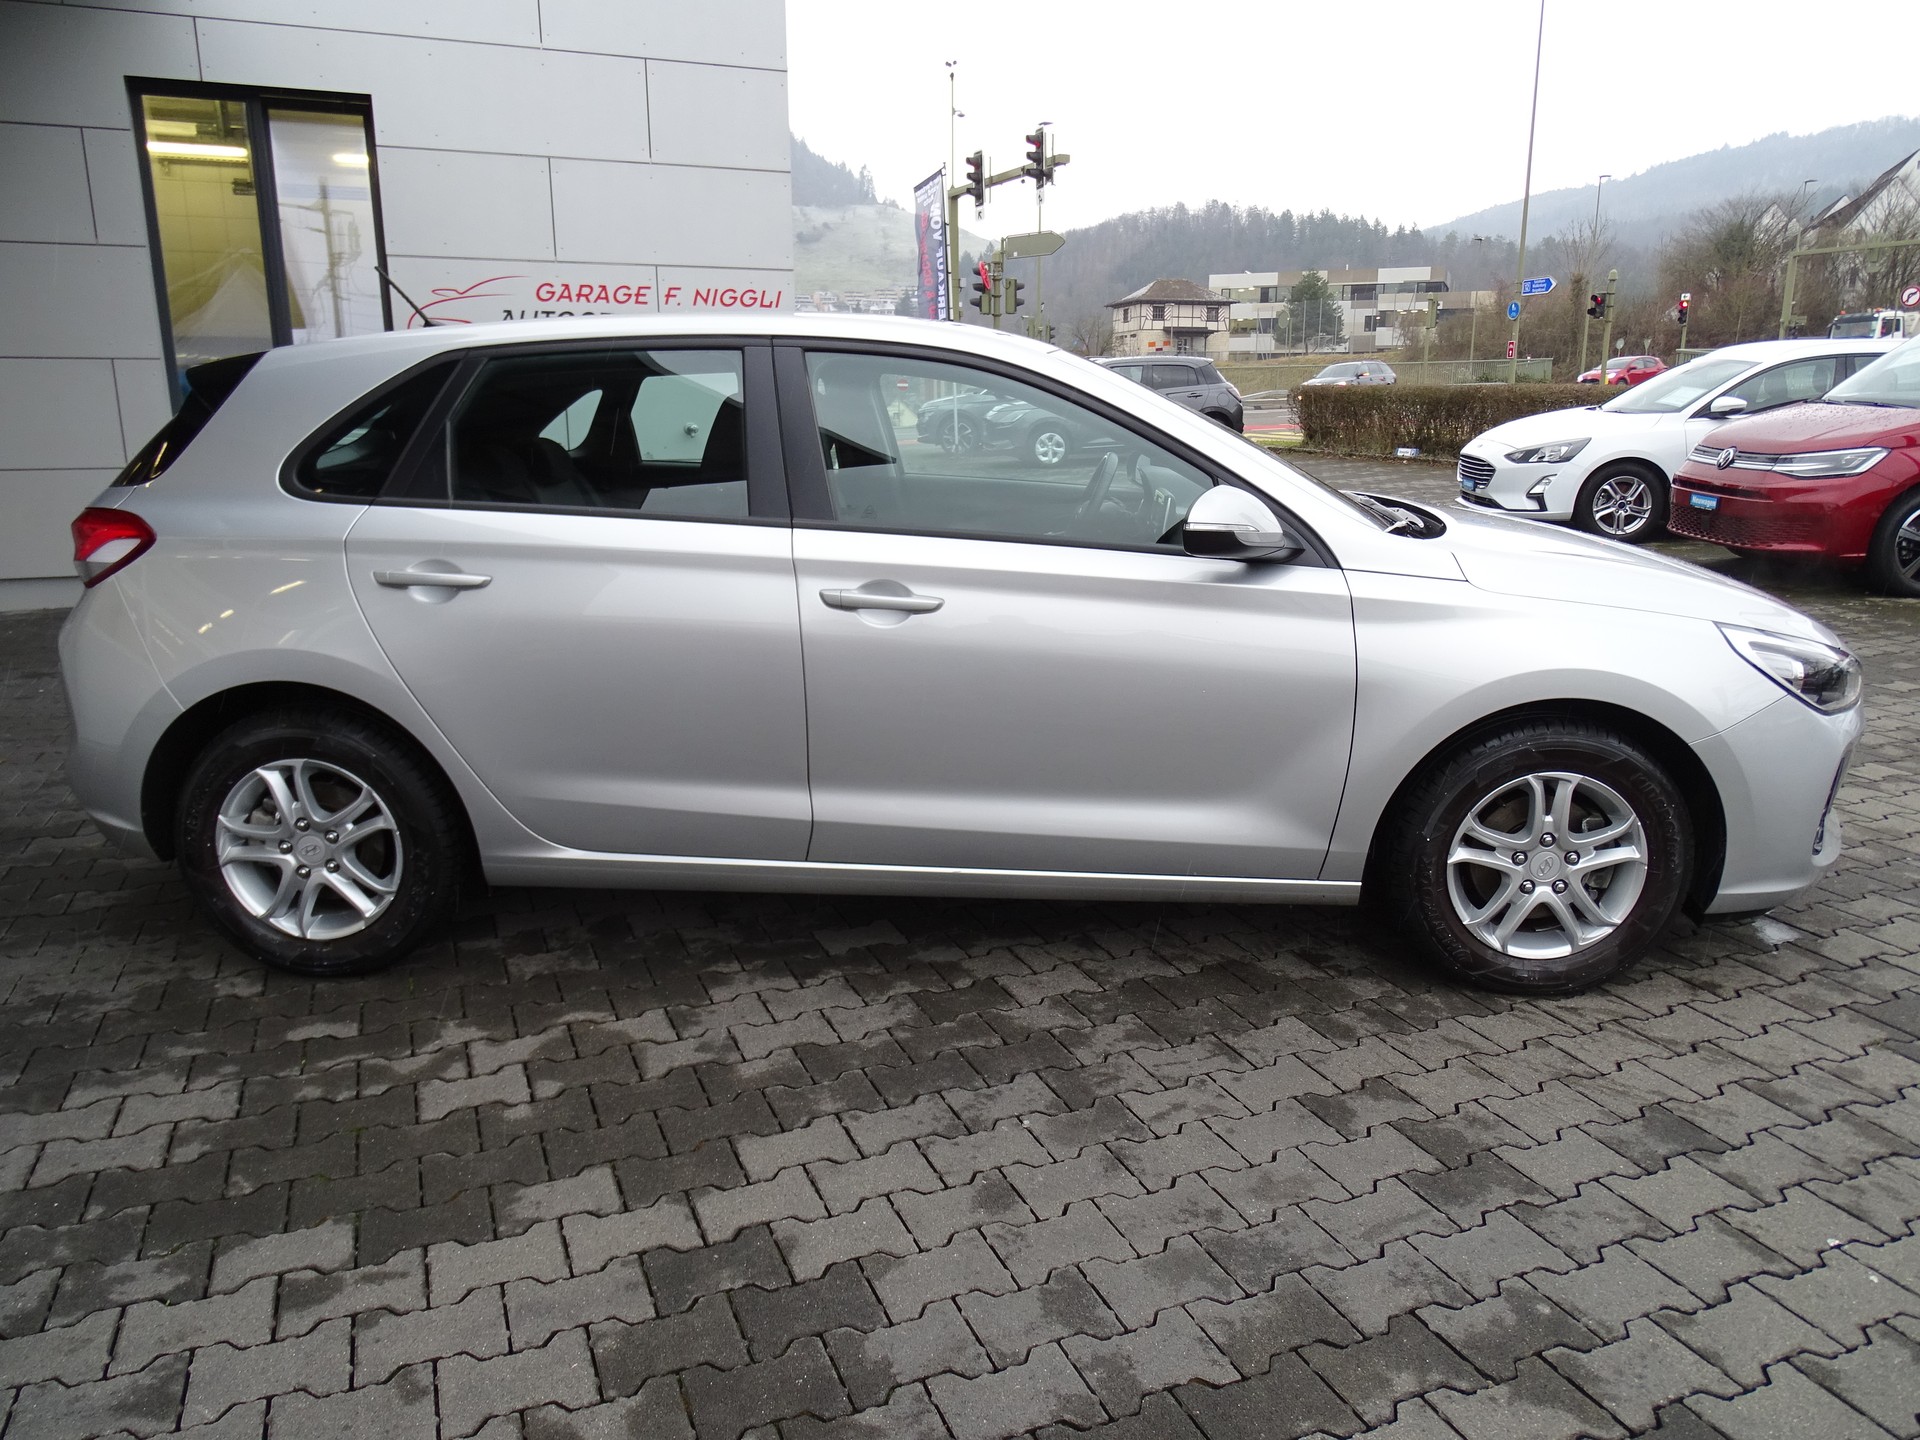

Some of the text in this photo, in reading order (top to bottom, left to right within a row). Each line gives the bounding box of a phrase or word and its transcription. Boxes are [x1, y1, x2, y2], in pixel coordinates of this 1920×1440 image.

[535, 282, 782, 309] GARAGE F. NIGGLI
